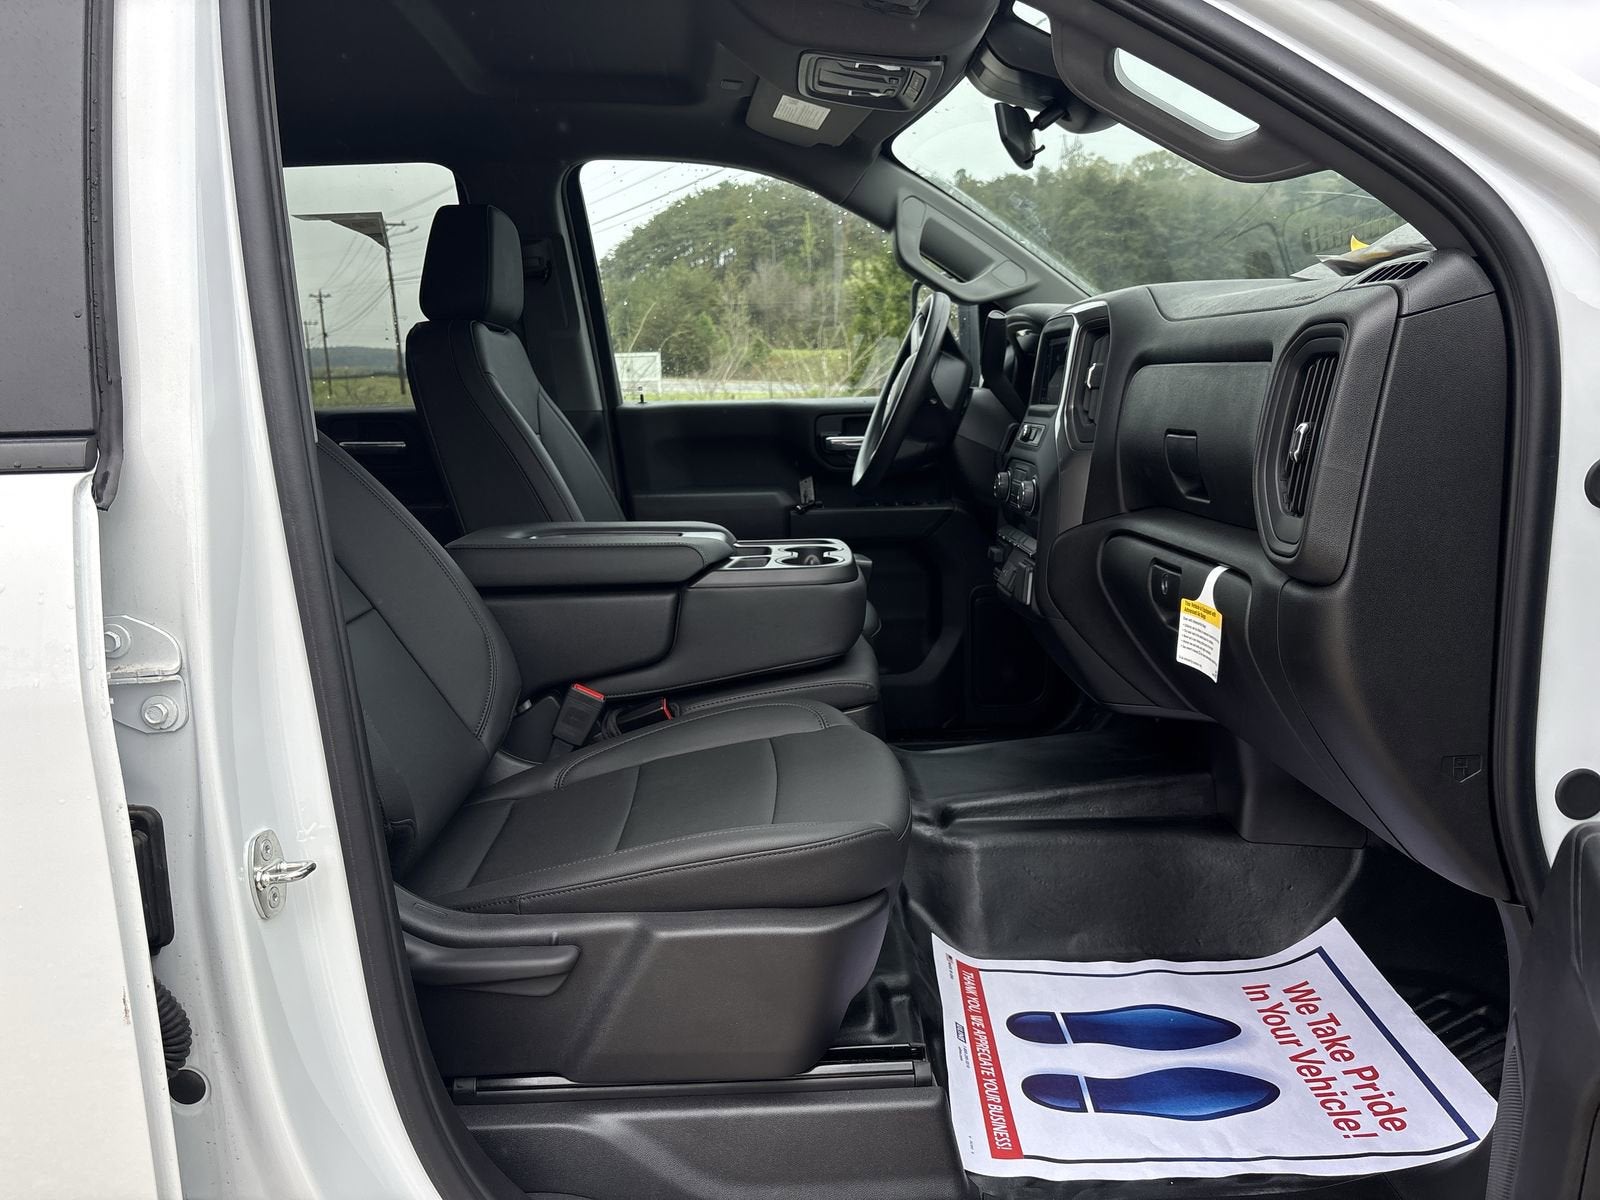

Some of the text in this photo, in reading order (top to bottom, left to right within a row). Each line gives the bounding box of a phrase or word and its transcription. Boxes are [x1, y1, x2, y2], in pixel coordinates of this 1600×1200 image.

[962, 970, 978, 997] THANK
[970, 1014, 985, 1030] WE
[972, 1028, 995, 1077] APPRECIATE
[1241, 983, 1379, 1139] In Your Vehicle!
[1282, 980, 1407, 1132] We Take Pride
[982, 1077, 1001, 1104] YOUR
[987, 1103, 1013, 1150] BUSINESS!
